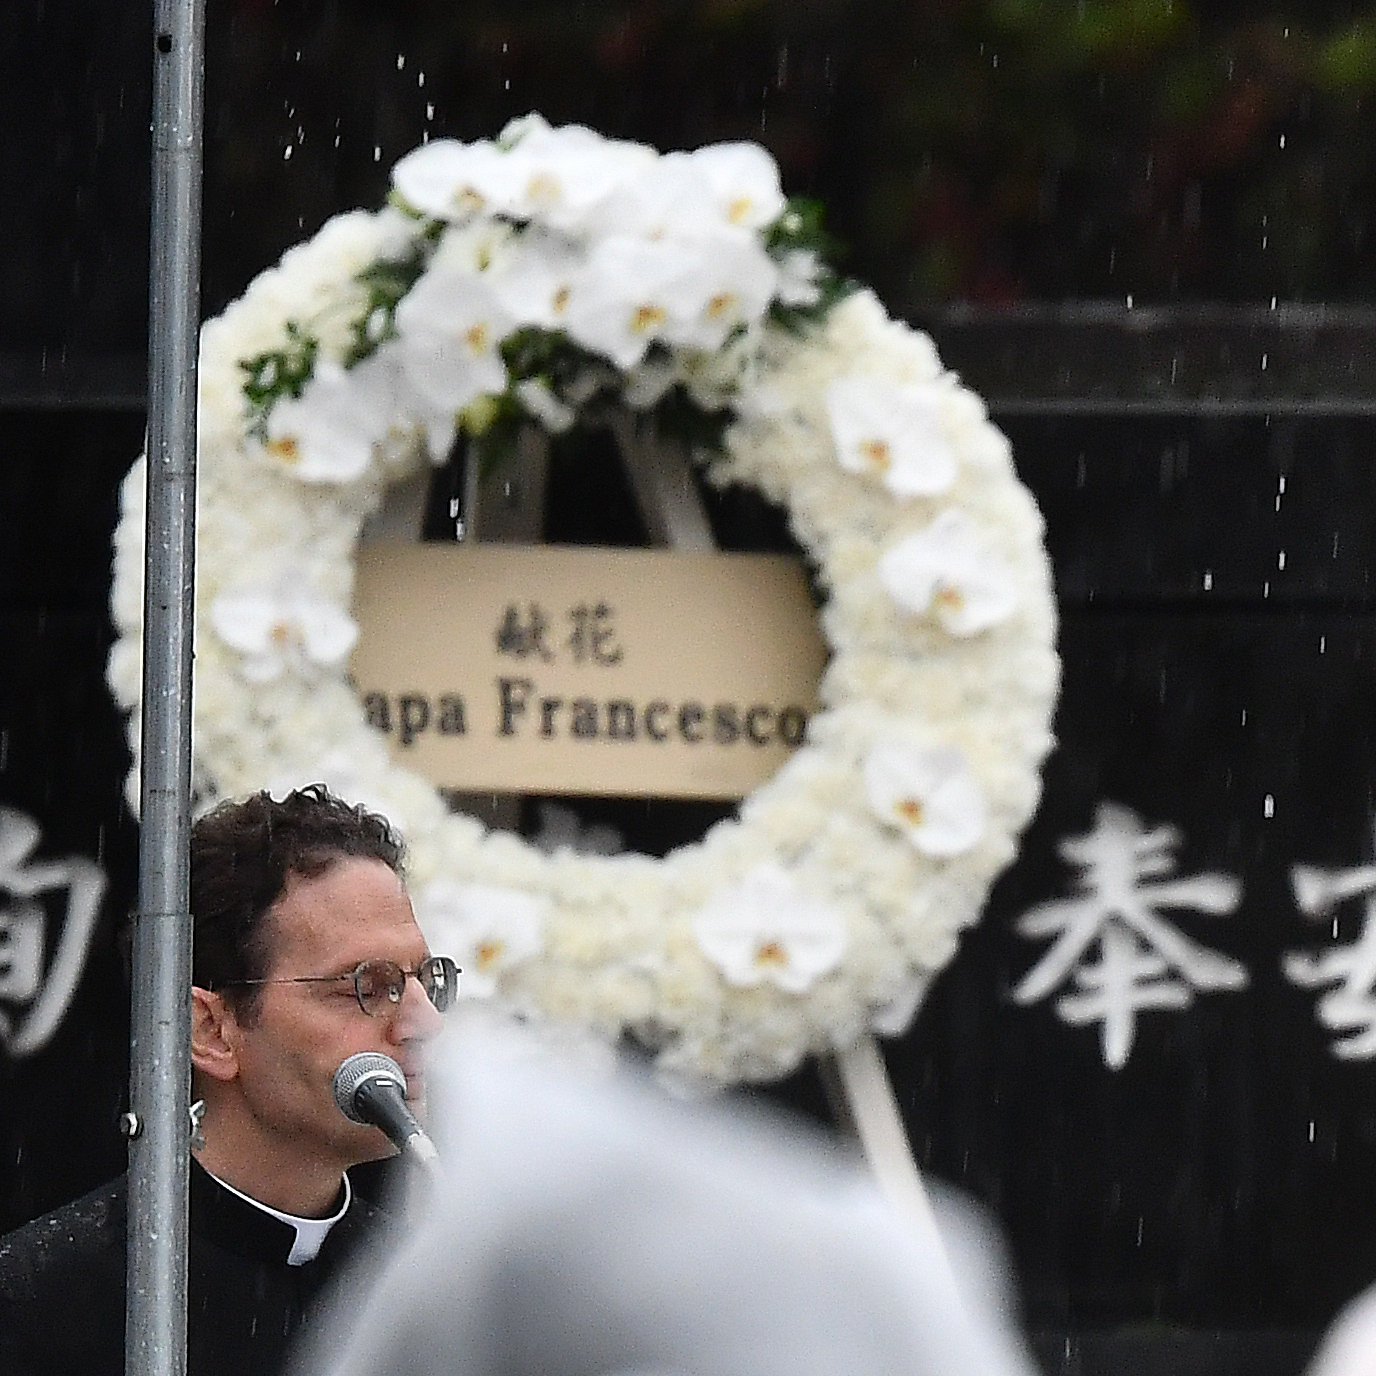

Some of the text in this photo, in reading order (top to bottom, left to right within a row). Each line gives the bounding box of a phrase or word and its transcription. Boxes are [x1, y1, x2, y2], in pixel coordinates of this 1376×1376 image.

[496, 601, 624, 667] 献花
[362, 676, 808, 747] apa Francesco
